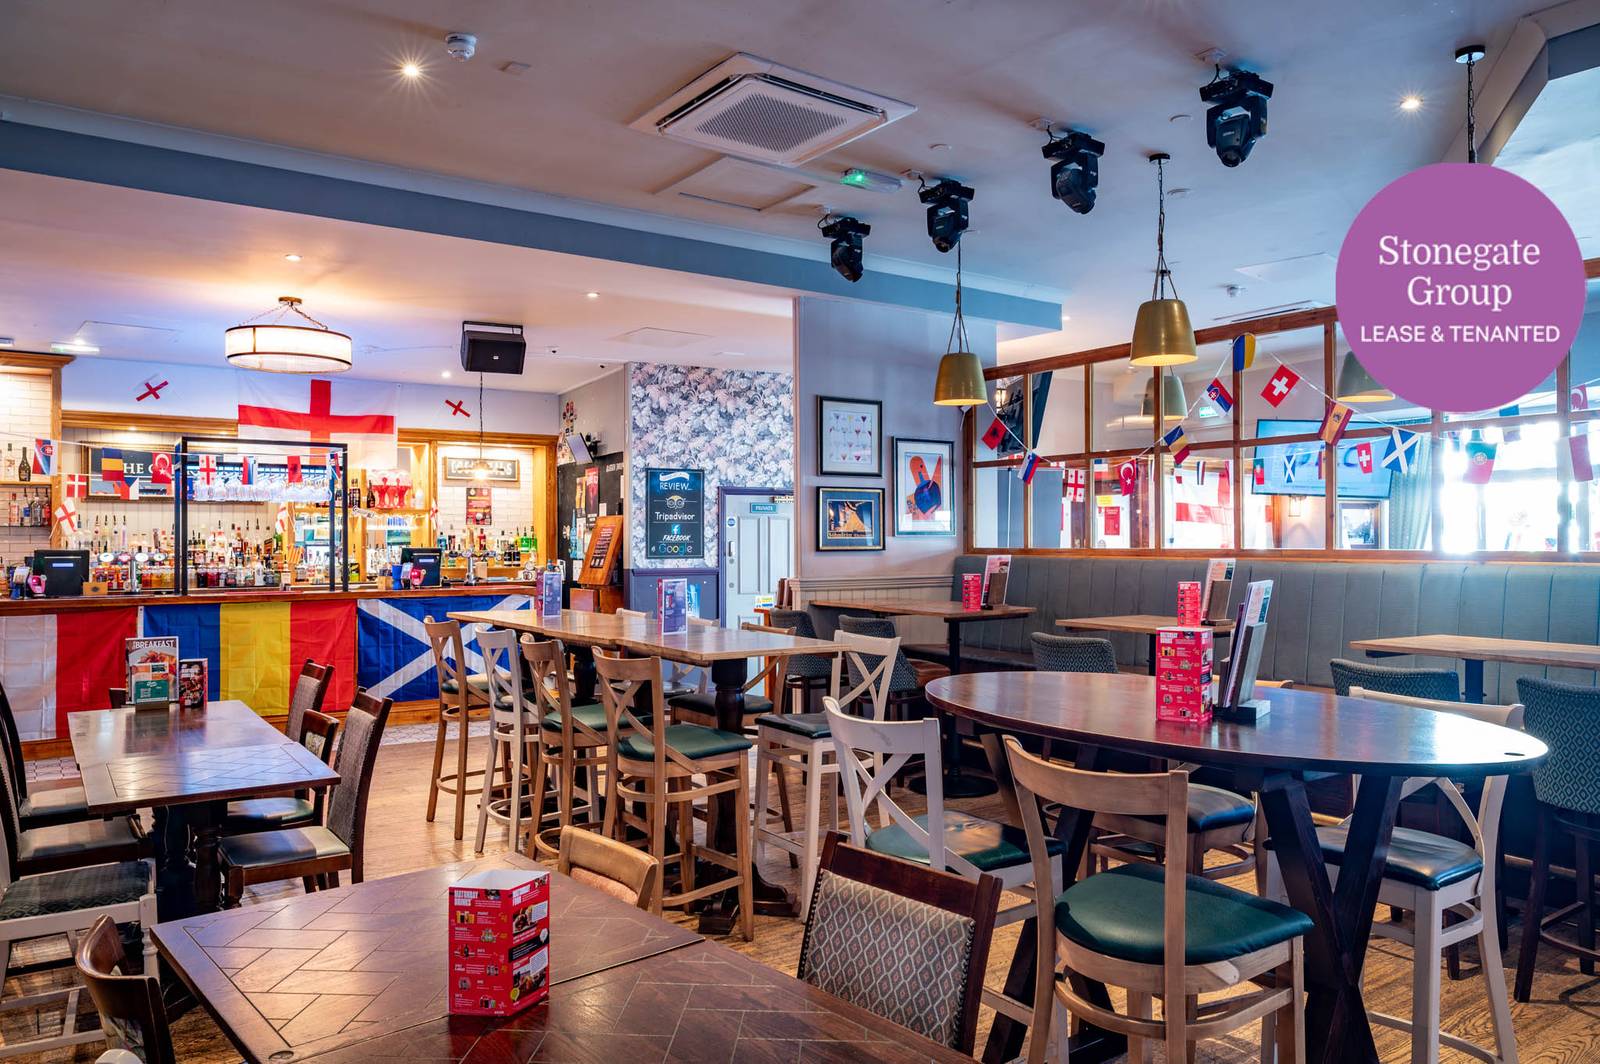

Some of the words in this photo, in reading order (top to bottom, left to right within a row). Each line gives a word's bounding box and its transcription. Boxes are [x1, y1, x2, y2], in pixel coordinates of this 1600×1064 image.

[654, 511, 696, 523] Tripadvisor
[662, 534, 692, 542] FACEBOOK
[658, 543, 693, 556] Google
[135, 640, 175, 649] BREAKFAST
